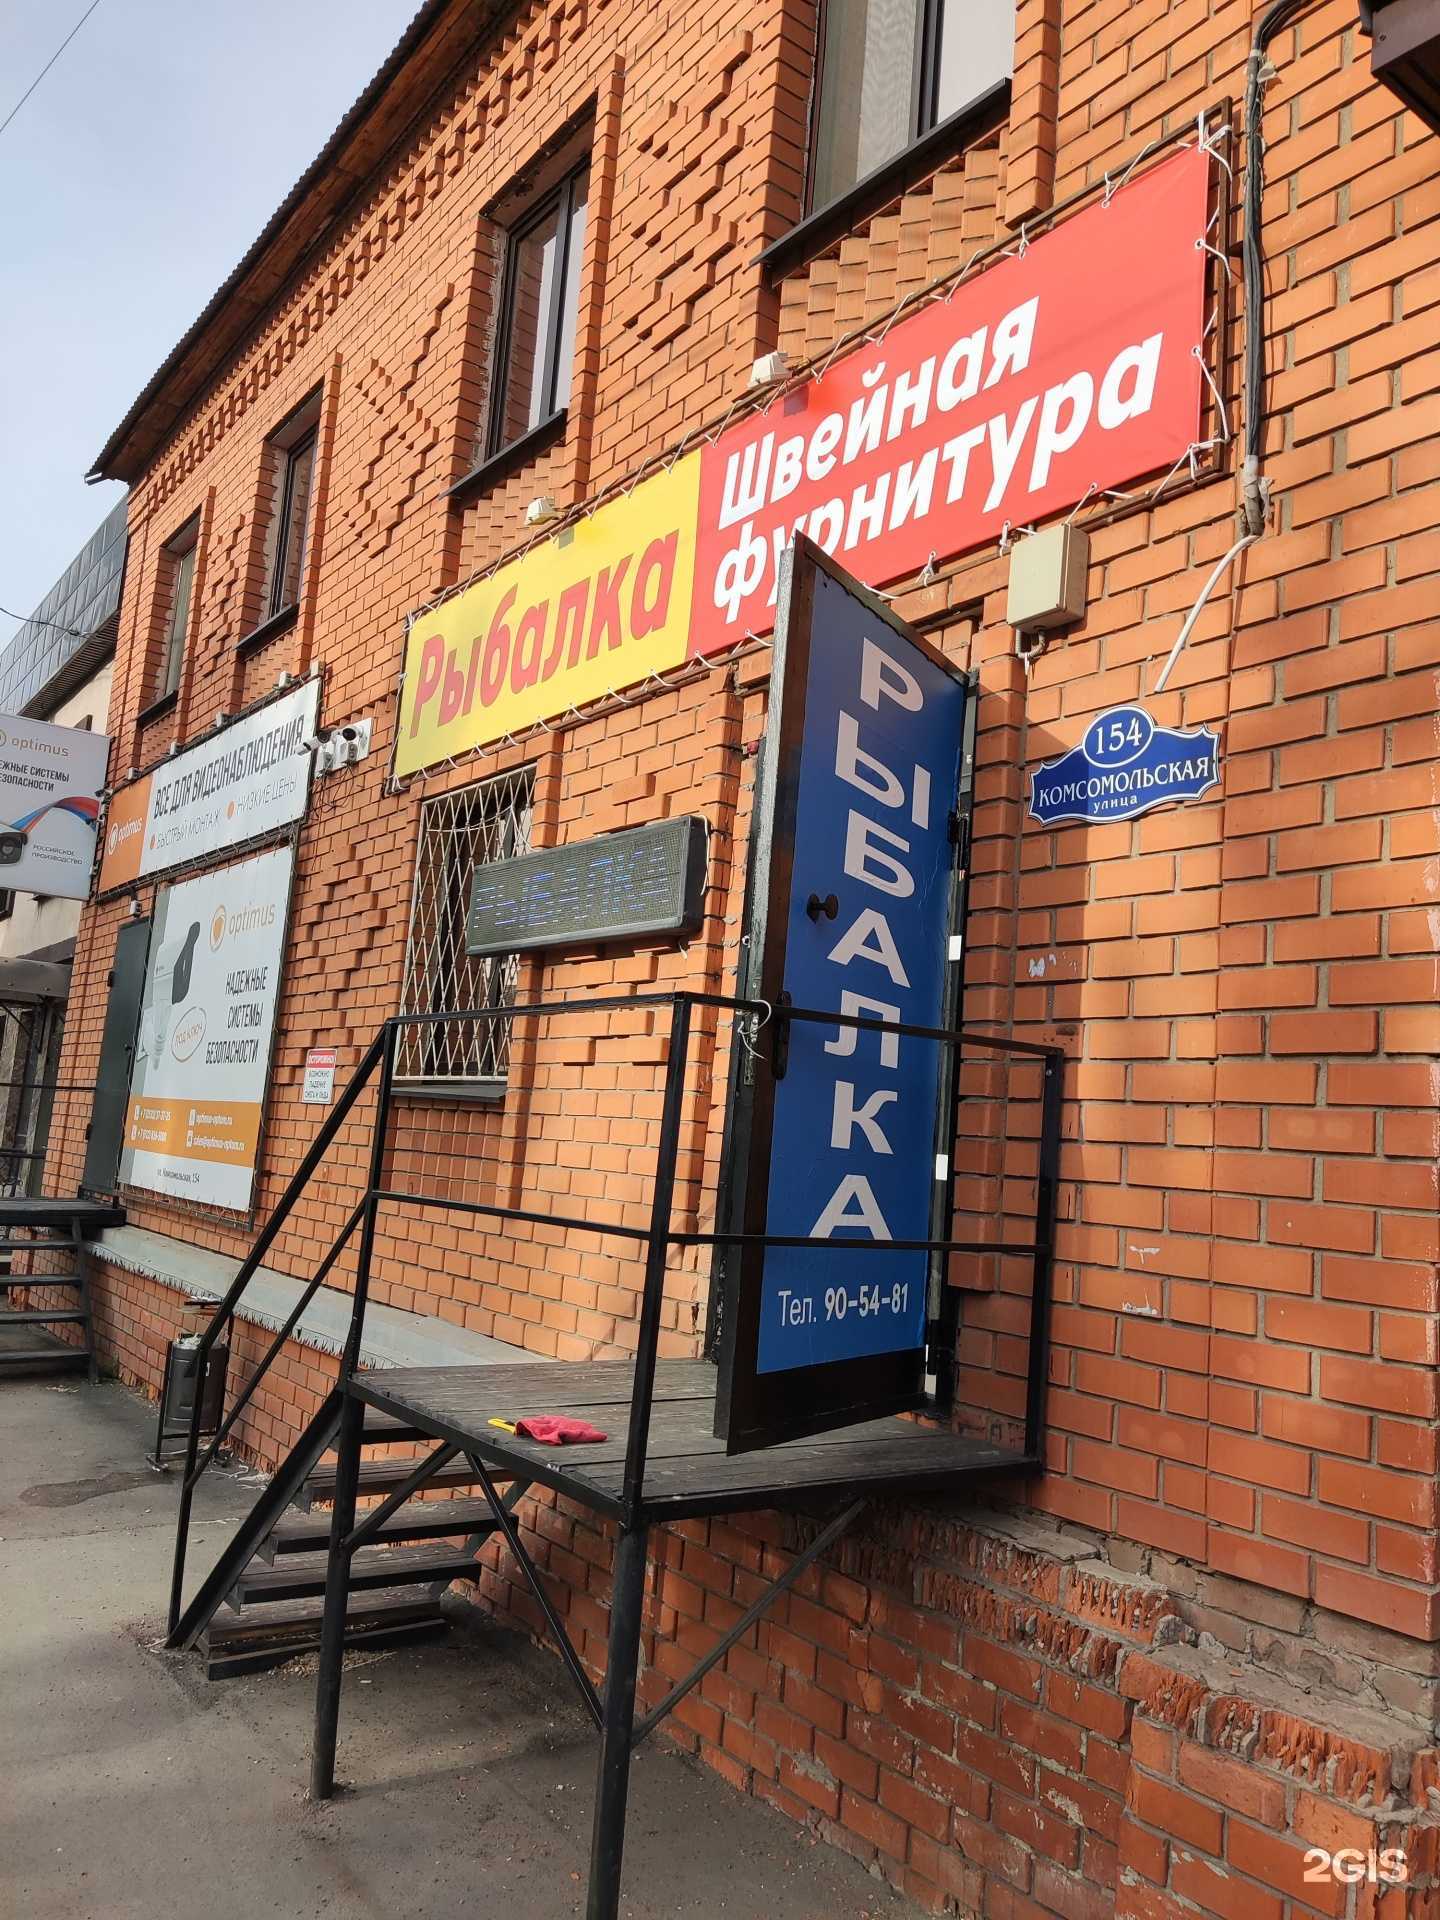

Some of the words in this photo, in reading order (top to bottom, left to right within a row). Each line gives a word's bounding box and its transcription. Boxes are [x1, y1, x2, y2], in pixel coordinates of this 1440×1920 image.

[717, 296, 1040, 531] Швейная
[409, 528, 680, 740] Рыбалка
[11, 737, 70, 758] optimus
[1094, 717, 1144, 756] 154
[29, 766, 70, 783] СИСТЕМЫ
[153, 782, 172, 820] ВСЕ
[170, 774, 193, 817] ДЛЯ
[191, 713, 306, 804] ВИДЕОНАБЛЮДЕНИЯ
[1038, 756, 1210, 808] КОМСОМОЛЬСКАЯ
[236, 781, 271, 817] НИЗКИЕ
[271, 772, 300, 802] ЦЕНЫ
[1093, 795, 1138, 814] улица
[186, 806, 223, 835] МОНТАЖ
[228, 903, 276, 942] optimus
[807, 636, 932, 1242] РЫБАЛКА
[225, 965, 269, 998] НАДЕЖНЫЕ
[227, 1002, 265, 1030] СИСТЕМЫ
[205, 1038, 259, 1065] БЕЗОПАСНОСТИ
[777, 1290, 817, 1327] Тел.
[823, 1283, 909, 1321] 90-54-81
